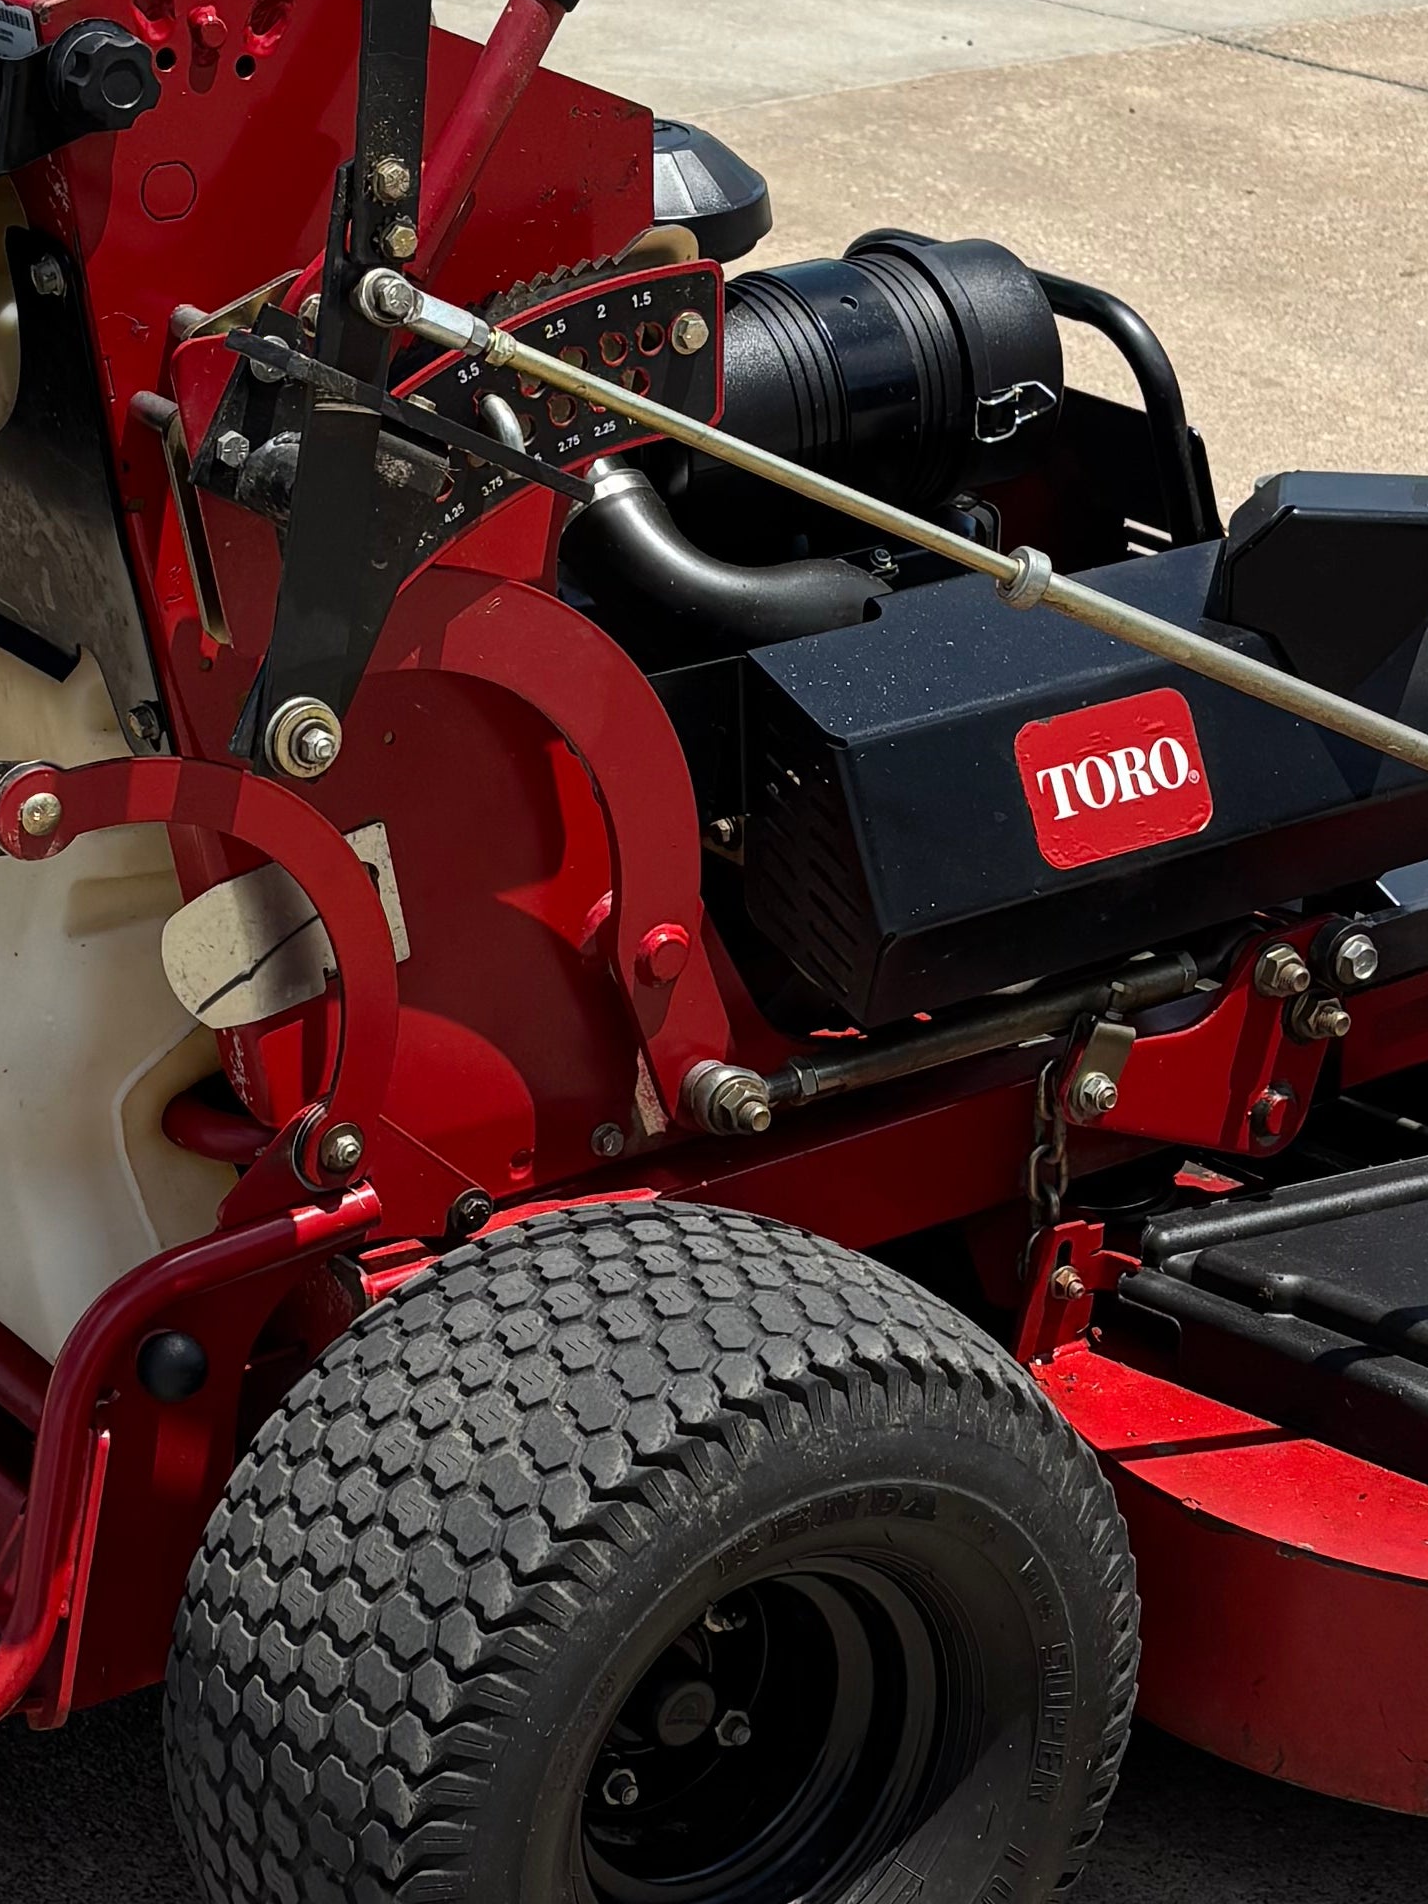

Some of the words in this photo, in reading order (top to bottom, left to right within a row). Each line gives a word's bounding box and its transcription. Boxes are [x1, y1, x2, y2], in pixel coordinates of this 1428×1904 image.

[458, 362, 480, 384] 3.5
[544, 319, 567, 339] 2.5
[597, 304, 607, 319] 2
[632, 291, 652, 308] 1.5
[443, 502, 465, 524] 4.25
[481, 475, 504, 497] 3.75
[557, 434, 581, 453] 2.75
[593, 420, 616, 438] 2.25
[1036, 737, 1190, 820] TORO
[1029, 1641, 1074, 1803] SUPER
